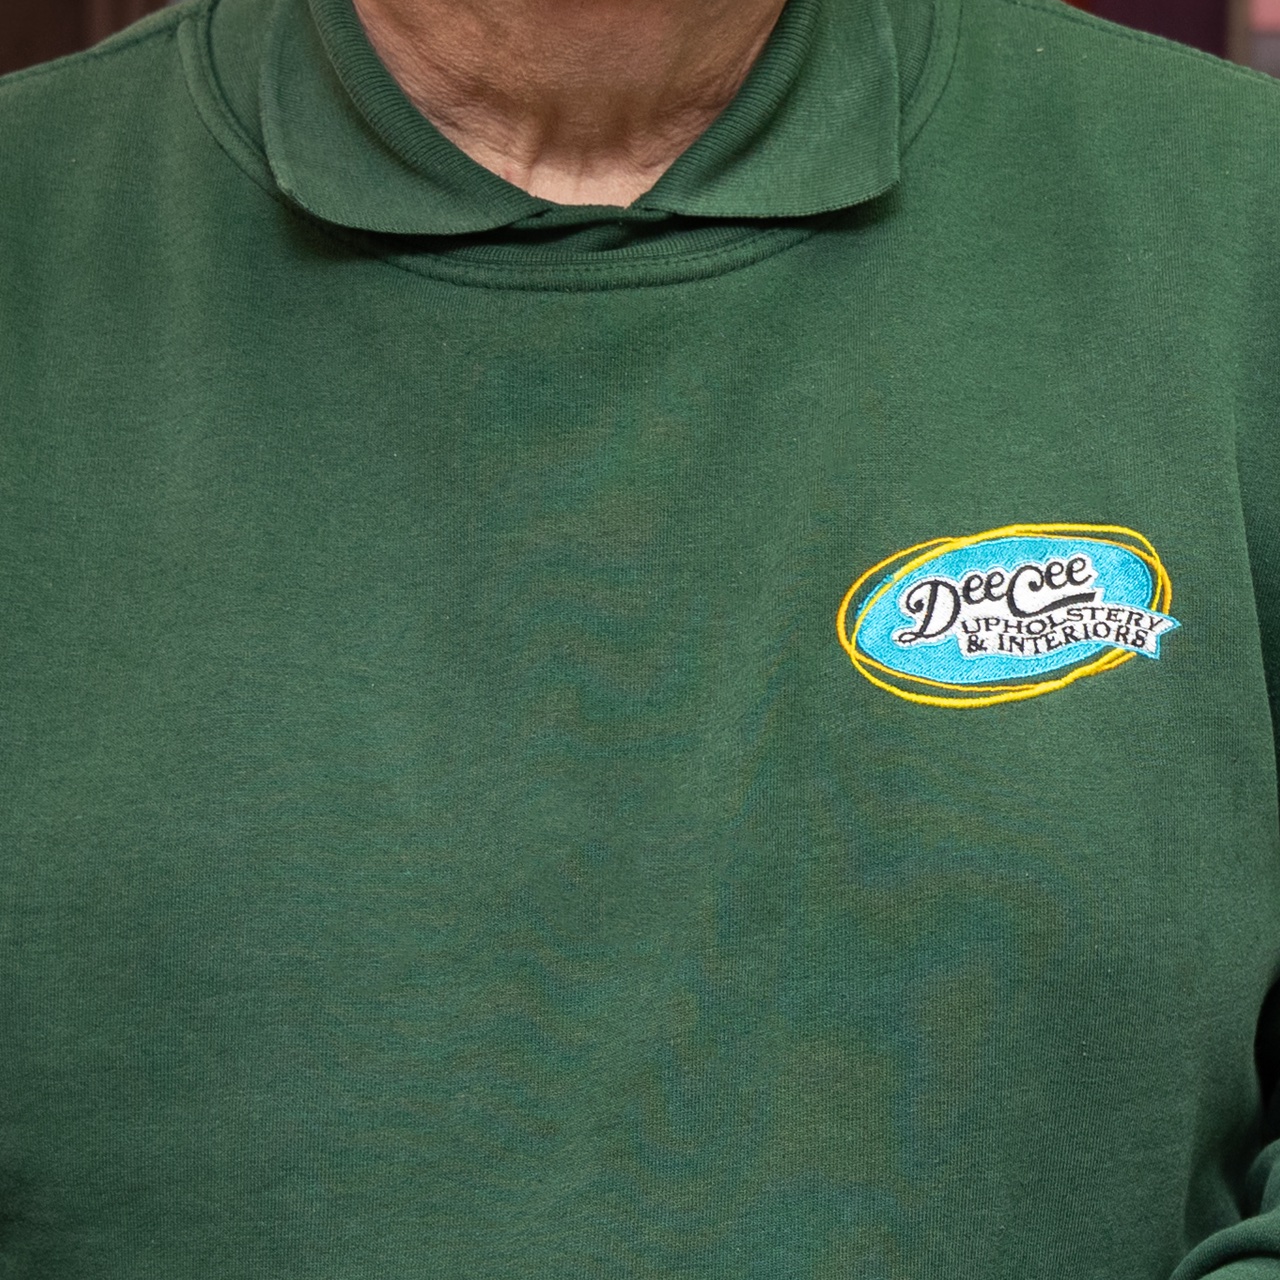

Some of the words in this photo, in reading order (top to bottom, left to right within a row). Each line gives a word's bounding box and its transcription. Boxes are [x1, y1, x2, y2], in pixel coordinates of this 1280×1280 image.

[960, 606, 1165, 636] UPHOLSTERY
[966, 633, 987, 654] &
[997, 620, 1149, 654] INTERIORS
